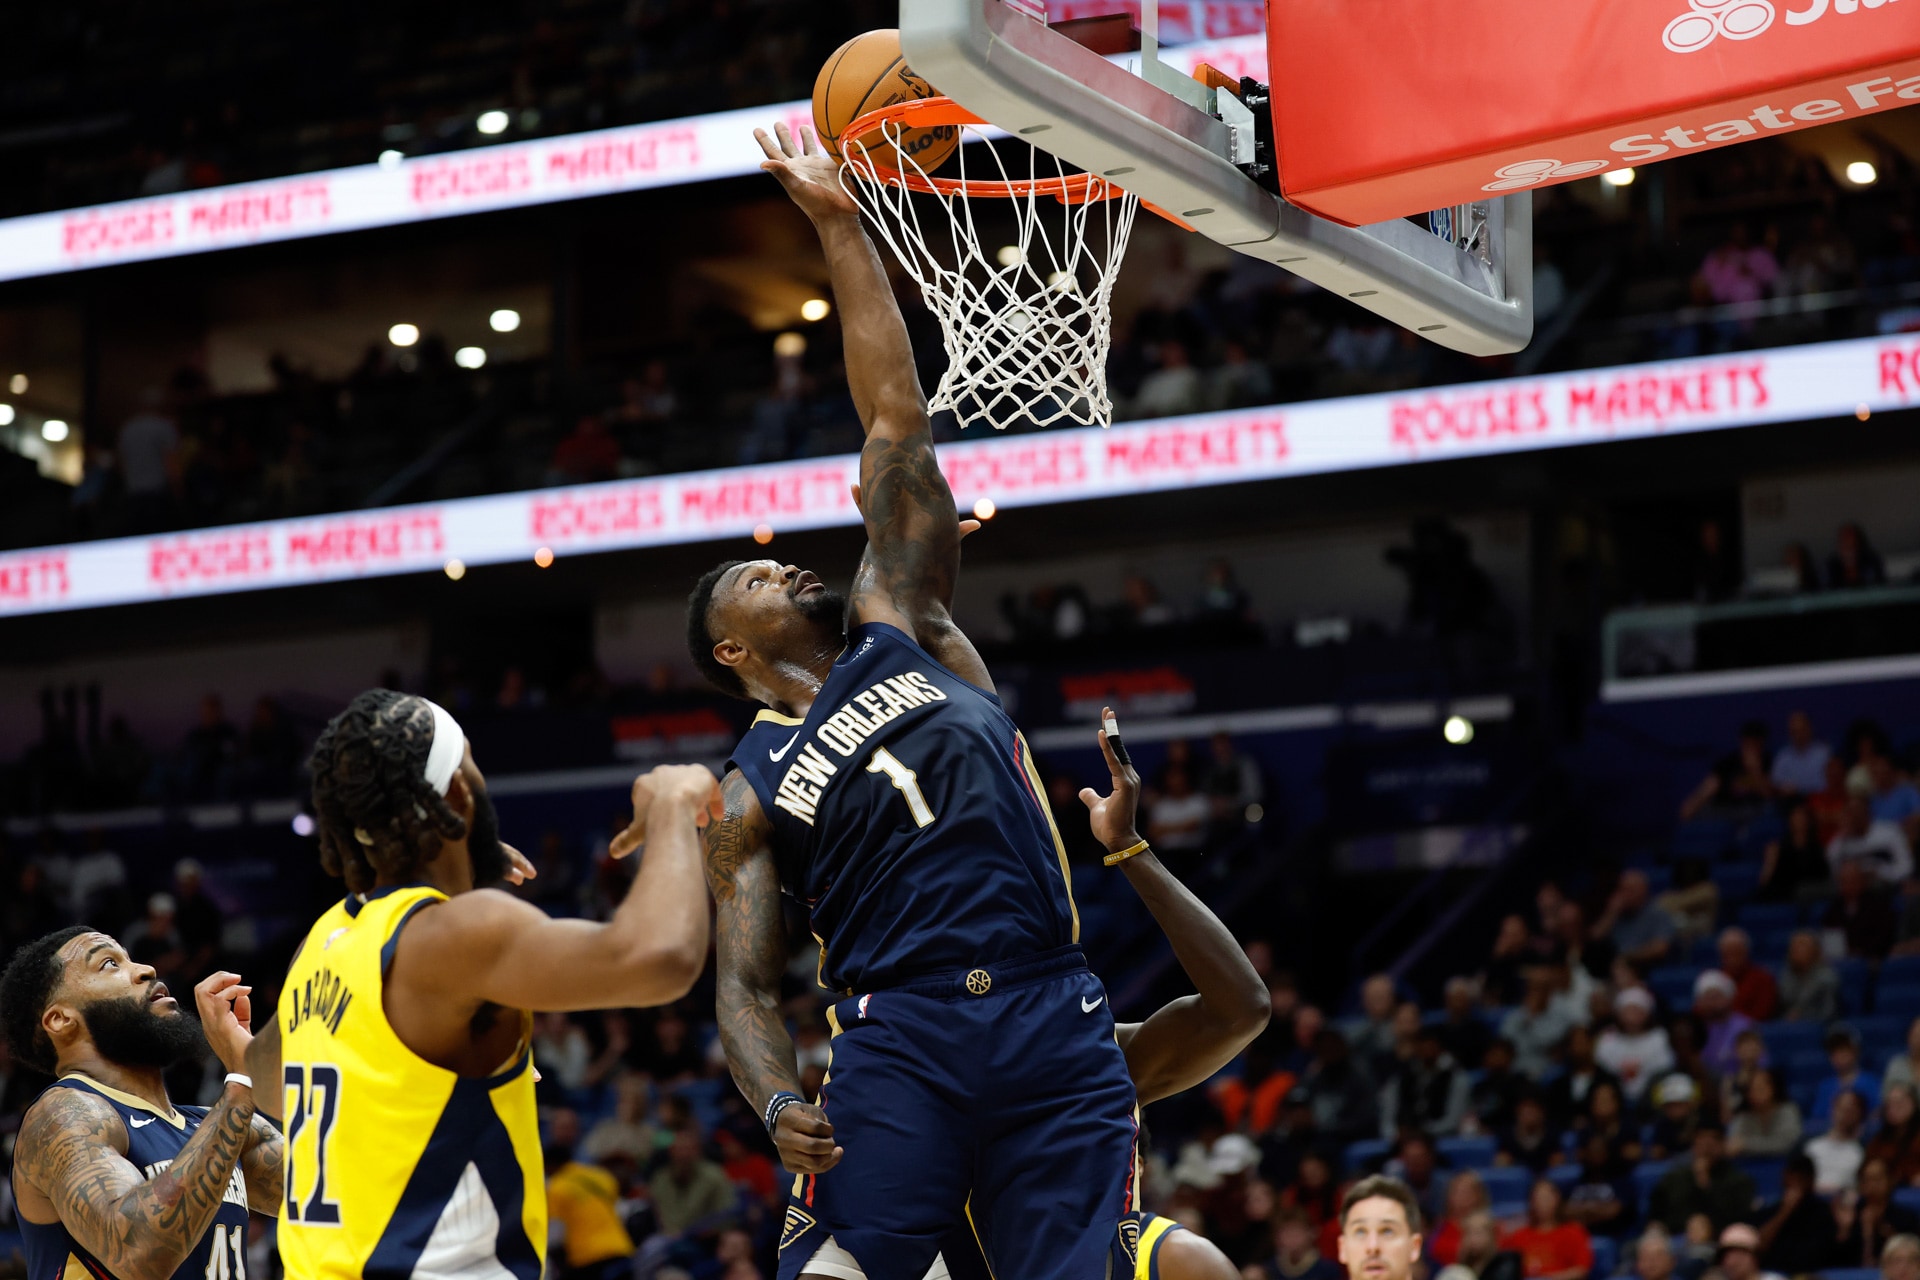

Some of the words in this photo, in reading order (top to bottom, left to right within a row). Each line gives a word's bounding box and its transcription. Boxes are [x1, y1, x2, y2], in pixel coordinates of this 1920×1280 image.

[410, 152, 531, 205] ROUSES
[546, 126, 699, 184] MARKETS
[1609, 99, 1845, 162] State
[62, 203, 174, 258] ROUSES
[188, 179, 330, 236] MARKETS
[148, 530, 273, 588] ROUSES
[287, 510, 444, 570] MARKETS
[529, 486, 664, 542] ROUSES
[679, 465, 850, 524] MARKETS
[1104, 414, 1289, 478] MARKETS
[1389, 385, 1550, 453] ROUSES
[1566, 358, 1771, 430] MARKETS
[774, 741, 838, 827] NEW
[817, 671, 947, 757] ORLEANS
[865, 745, 936, 829] 1
[283, 1062, 342, 1228] 22
[205, 1223, 246, 1280] 41
